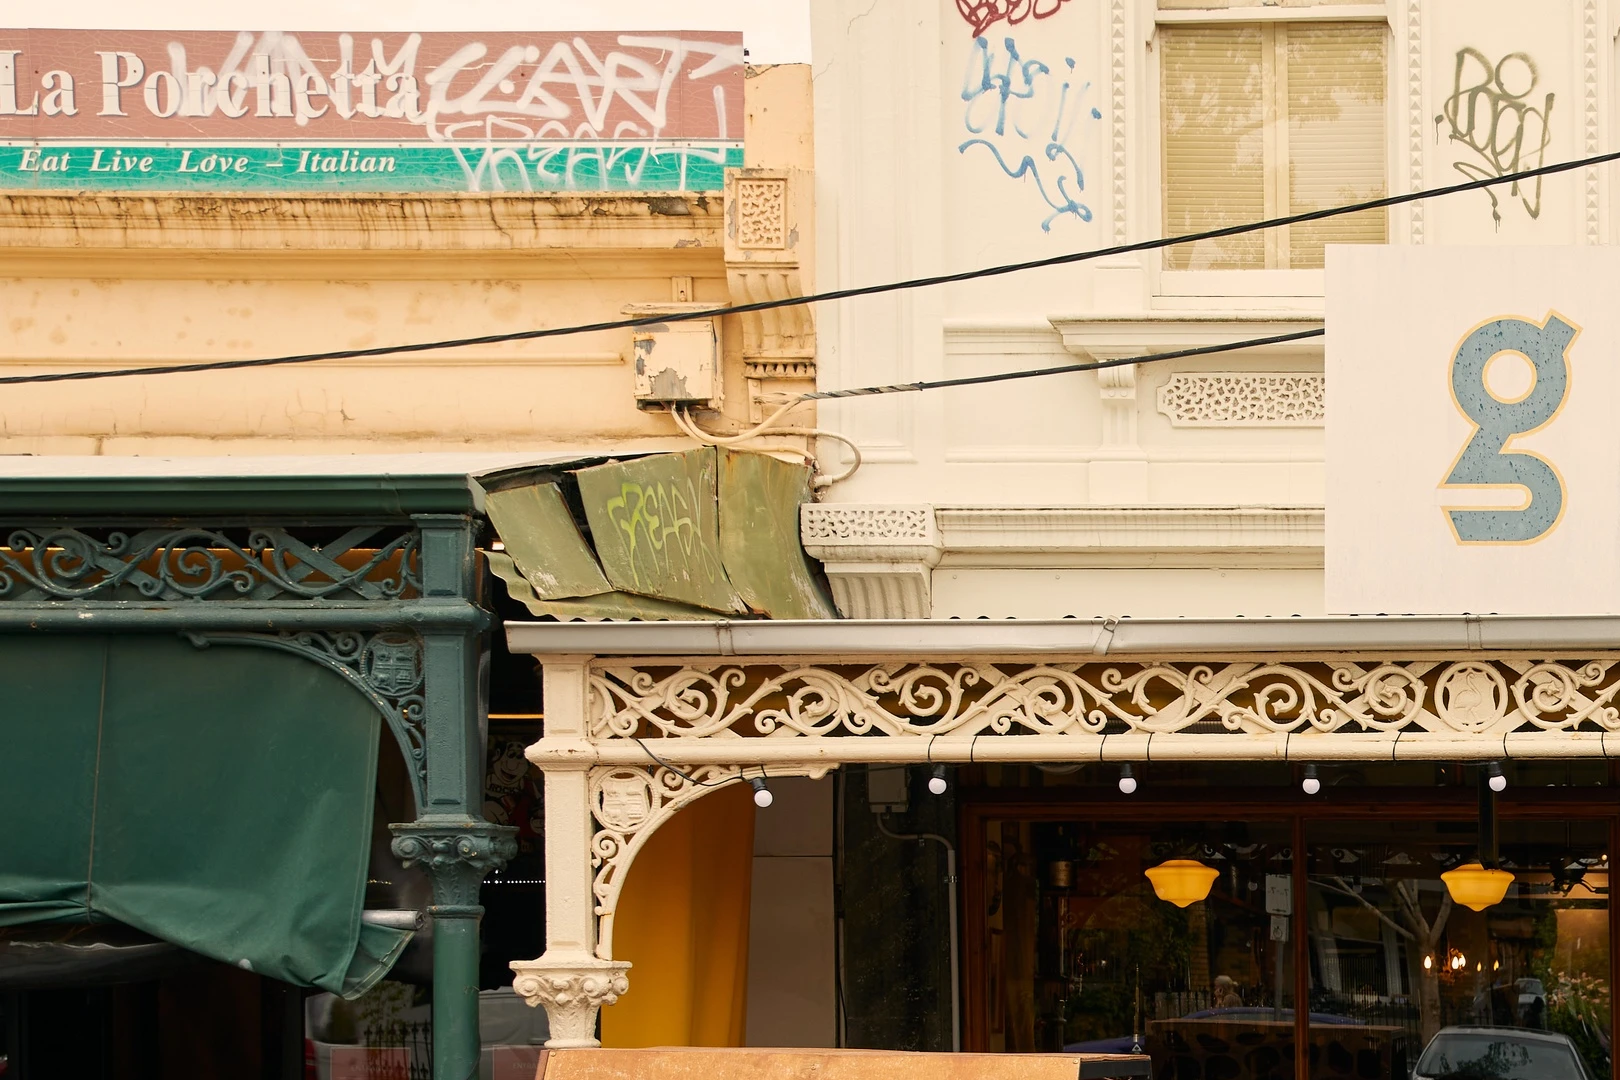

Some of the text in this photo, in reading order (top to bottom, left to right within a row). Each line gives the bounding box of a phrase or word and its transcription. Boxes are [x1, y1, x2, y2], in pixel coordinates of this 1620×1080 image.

[0, 50, 79, 117] La
[96, 51, 425, 119] Porchetta
[18, 148, 70, 172] Eat
[89, 149, 153, 172] Live
[178, 149, 248, 173] Love
[297, 149, 397, 173] Italian
[1437, 308, 1583, 546] g
